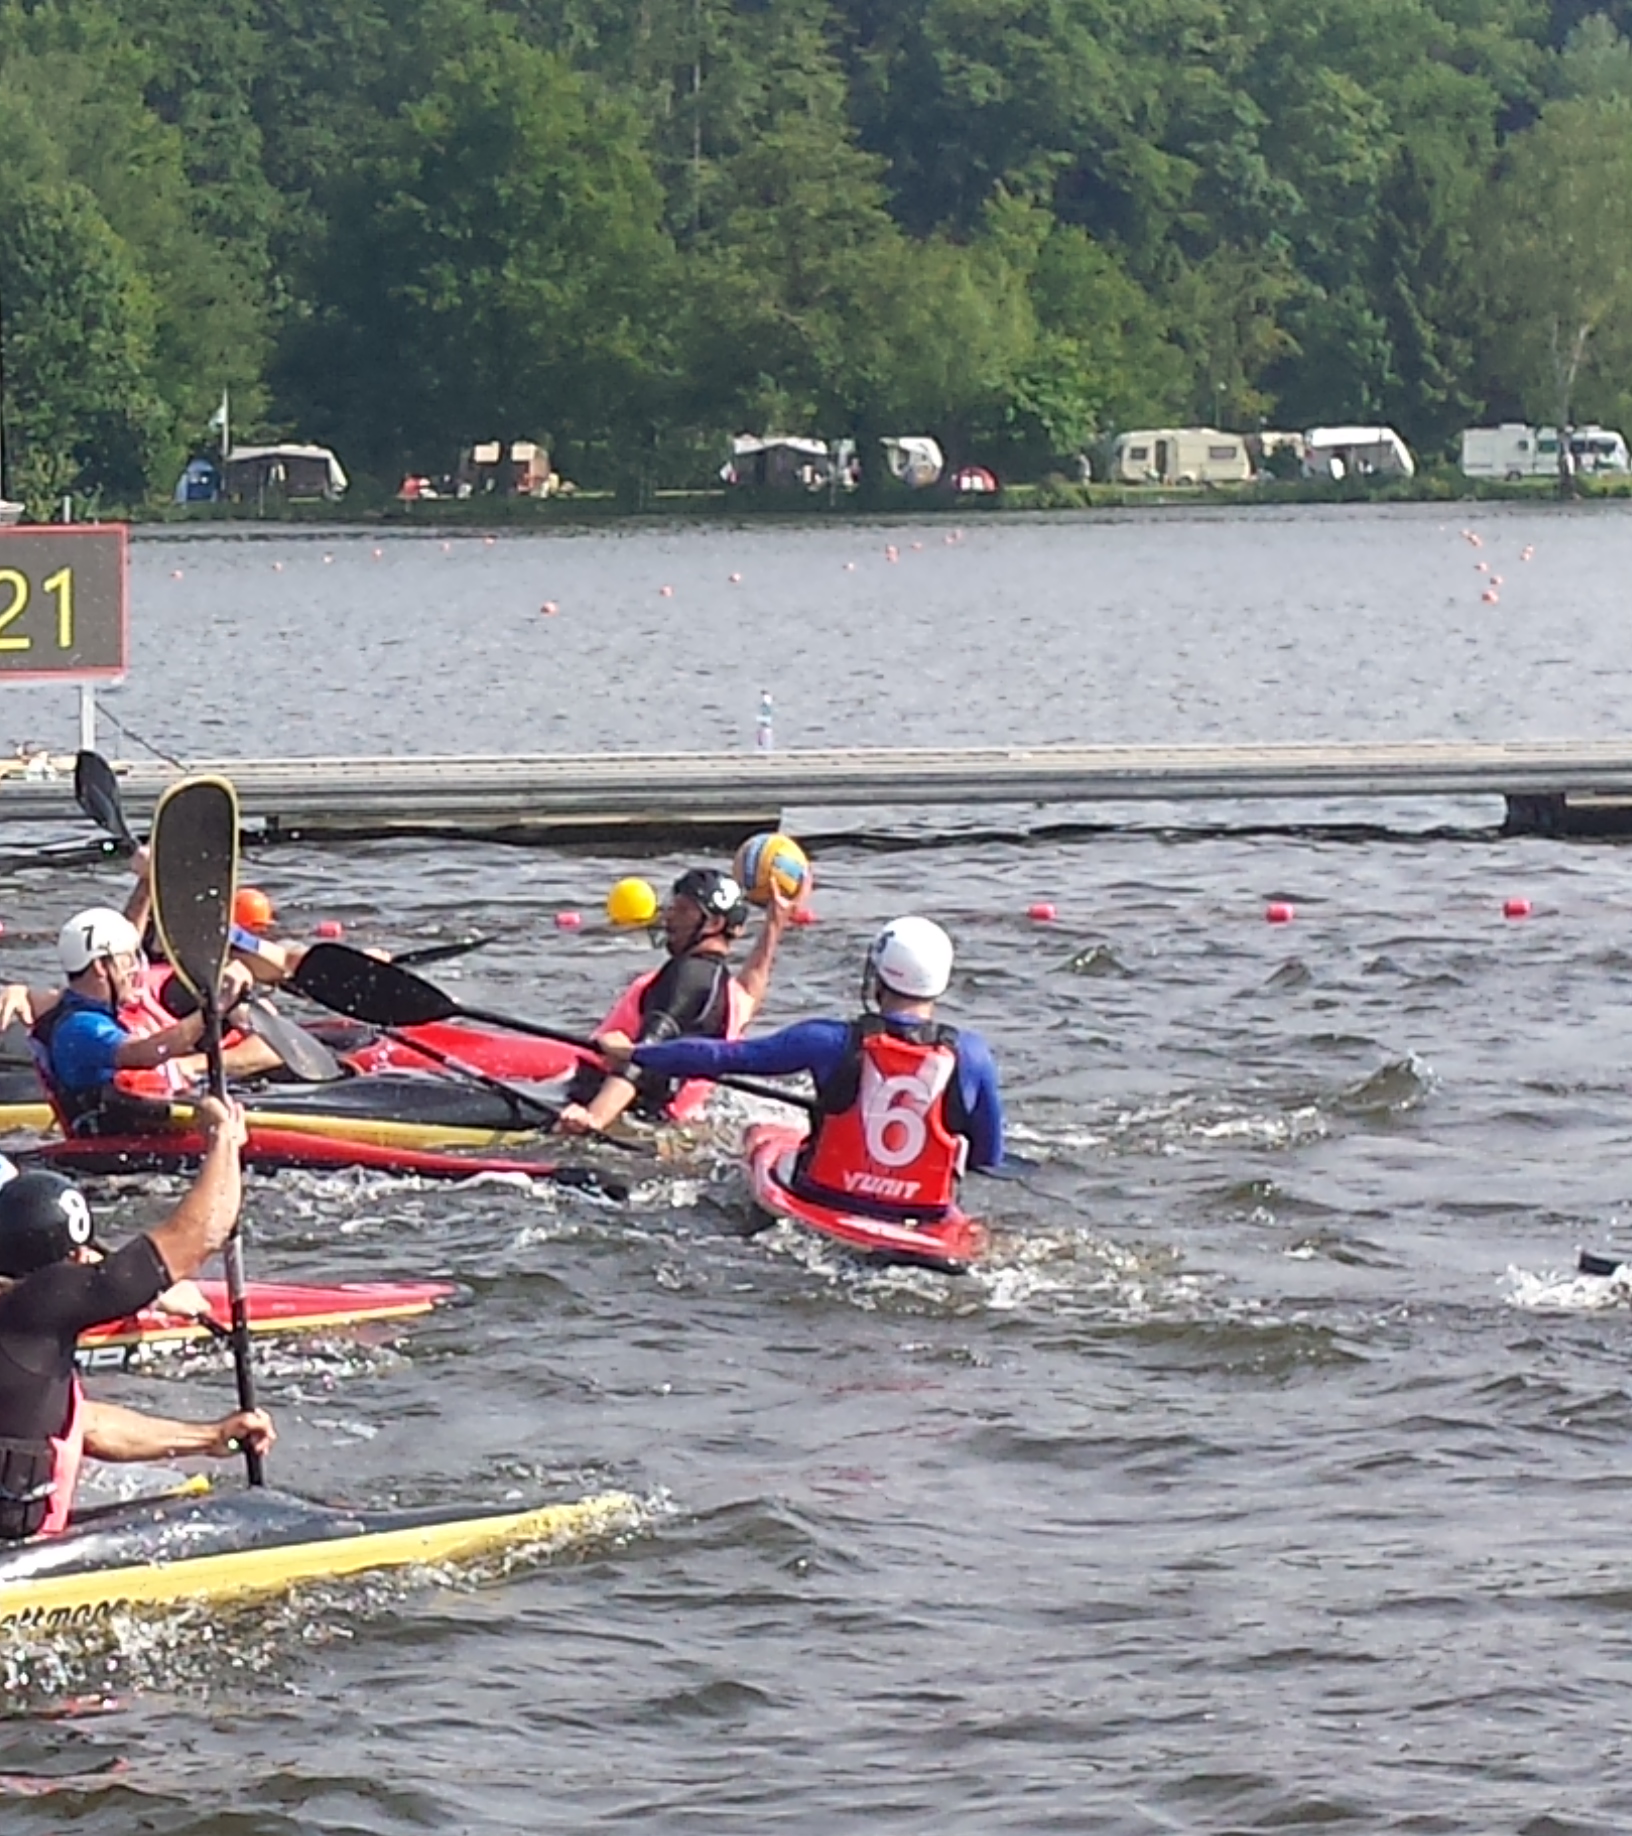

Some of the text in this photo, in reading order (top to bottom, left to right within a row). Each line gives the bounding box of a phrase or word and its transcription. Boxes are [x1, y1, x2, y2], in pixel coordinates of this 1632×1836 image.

[81, 924, 95, 952] 7
[868, 1075, 927, 1168] 6
[59, 1189, 91, 1244] 8
